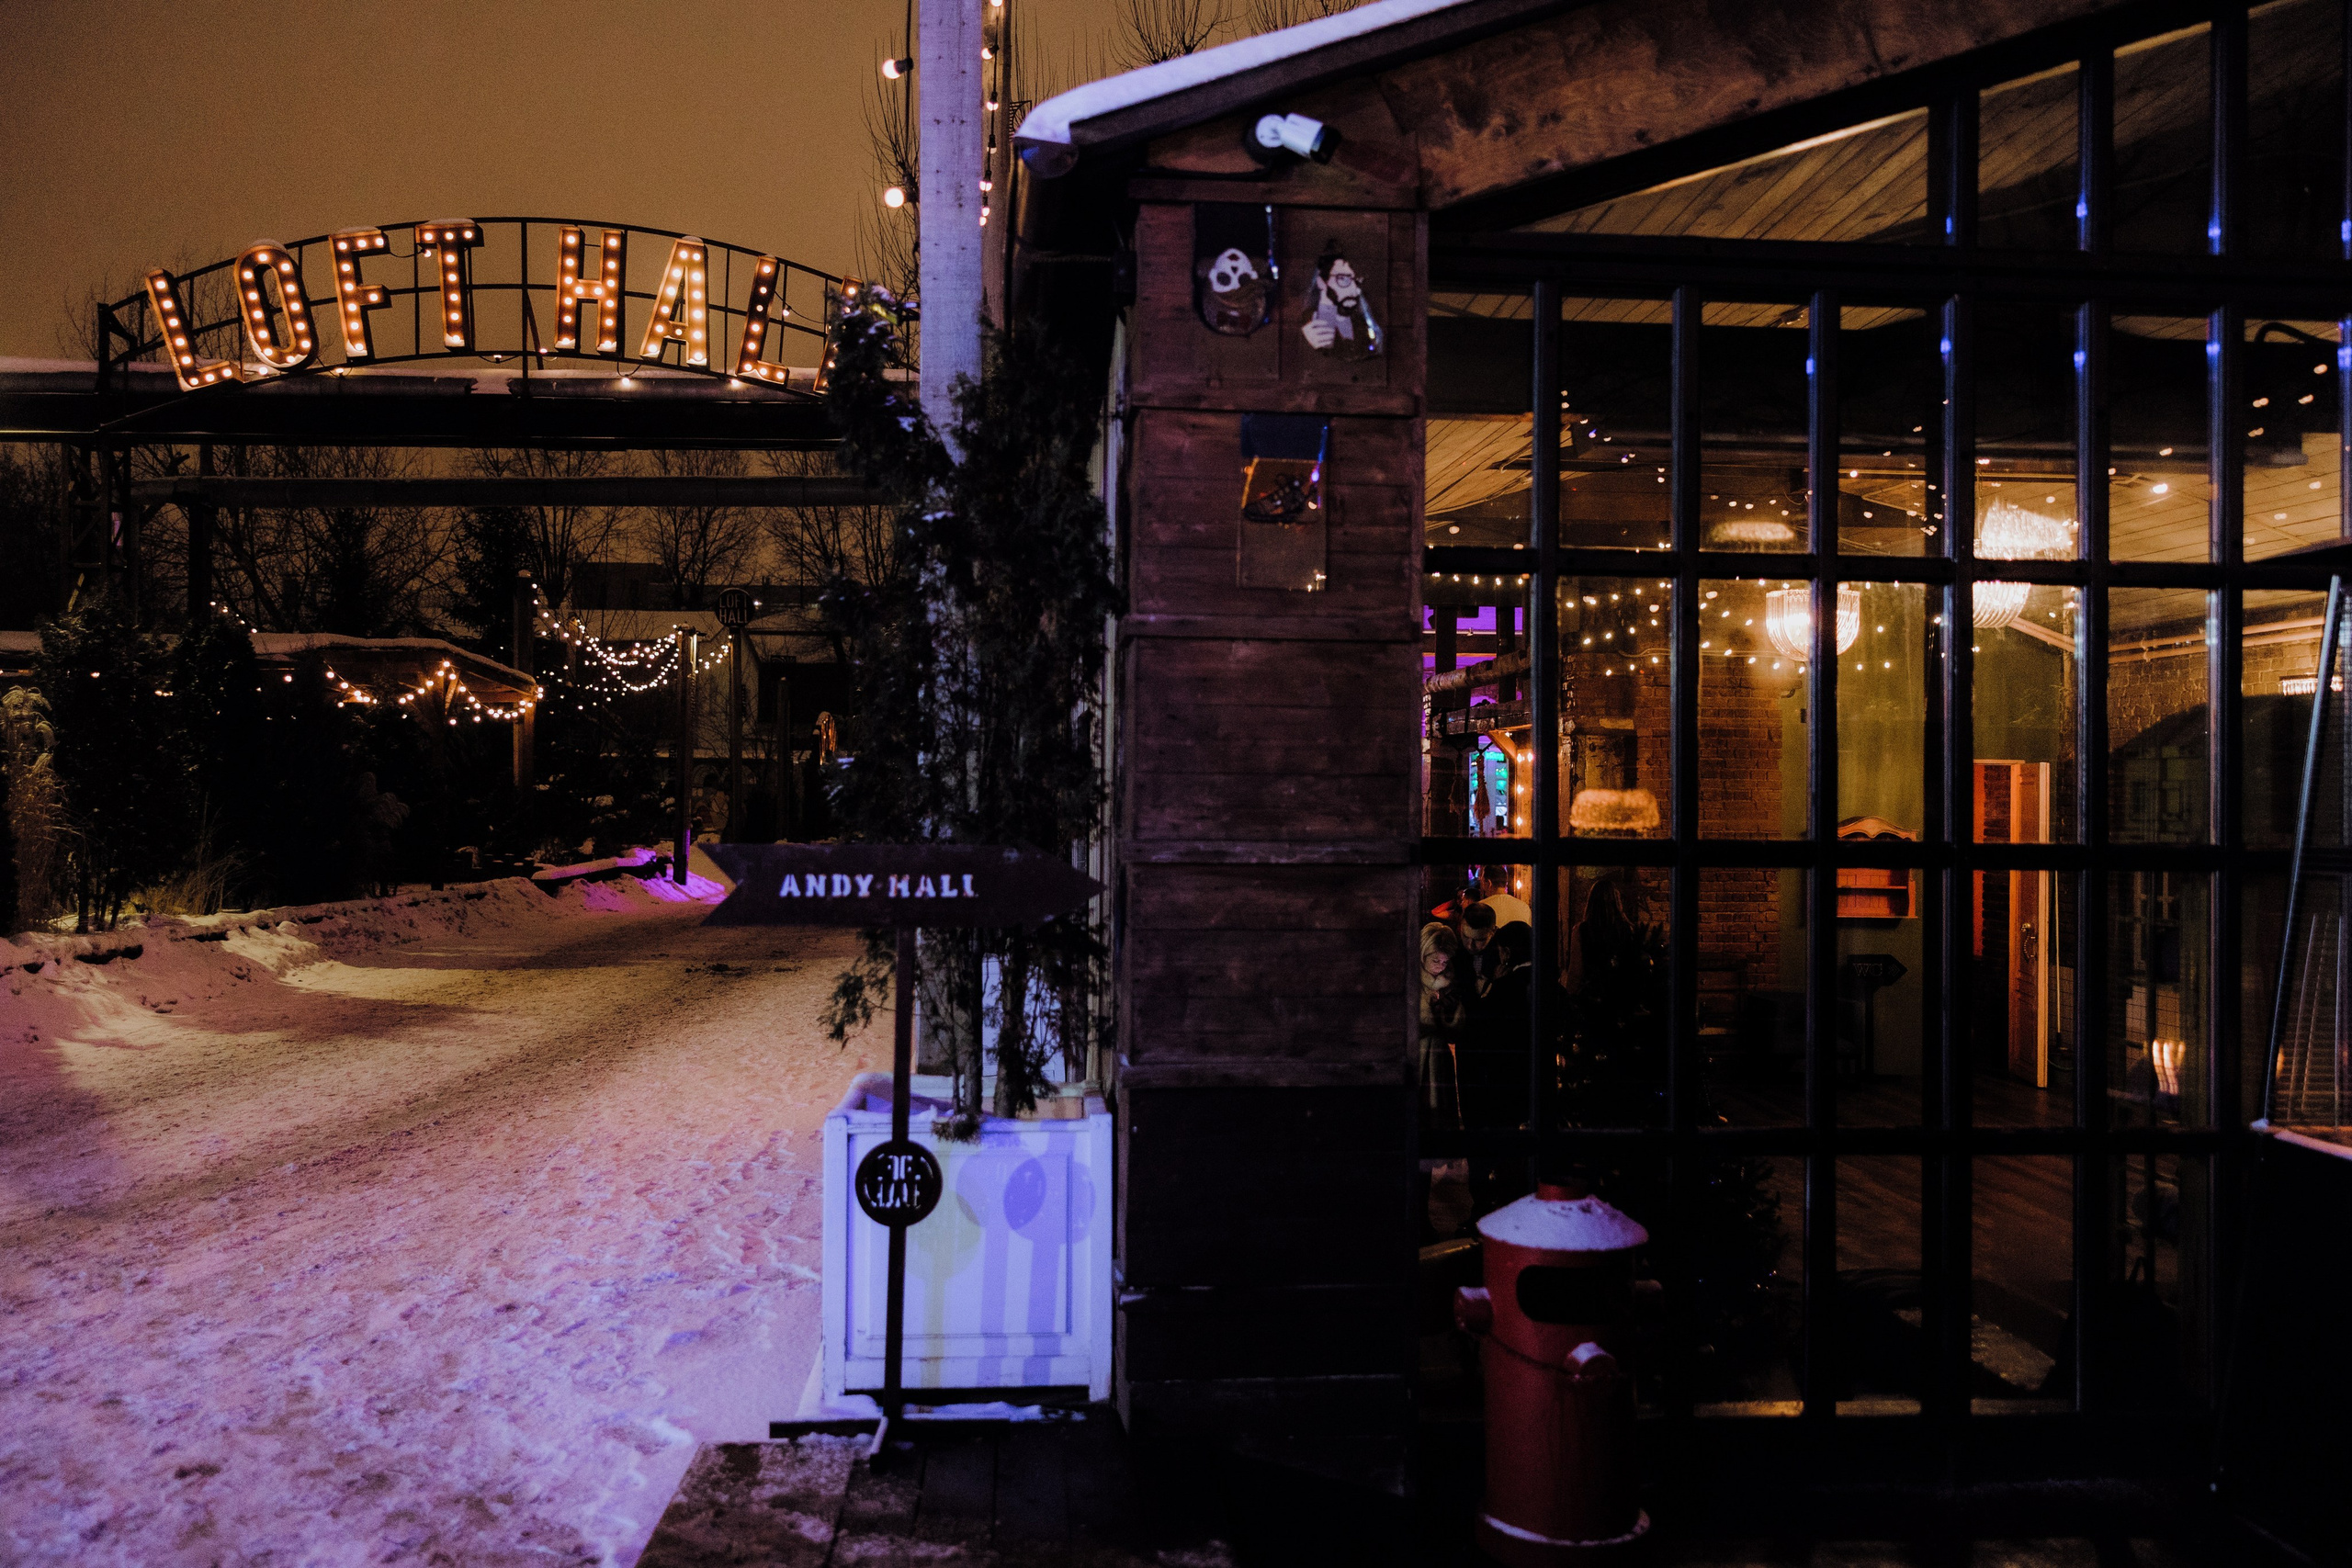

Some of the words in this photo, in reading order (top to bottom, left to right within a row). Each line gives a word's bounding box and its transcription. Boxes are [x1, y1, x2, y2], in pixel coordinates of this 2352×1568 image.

[144, 219, 484, 392] LOFT
[779, 873, 874, 898] ANDY
[888, 873, 979, 898] HALL
[1851, 963, 1883, 976] WC
